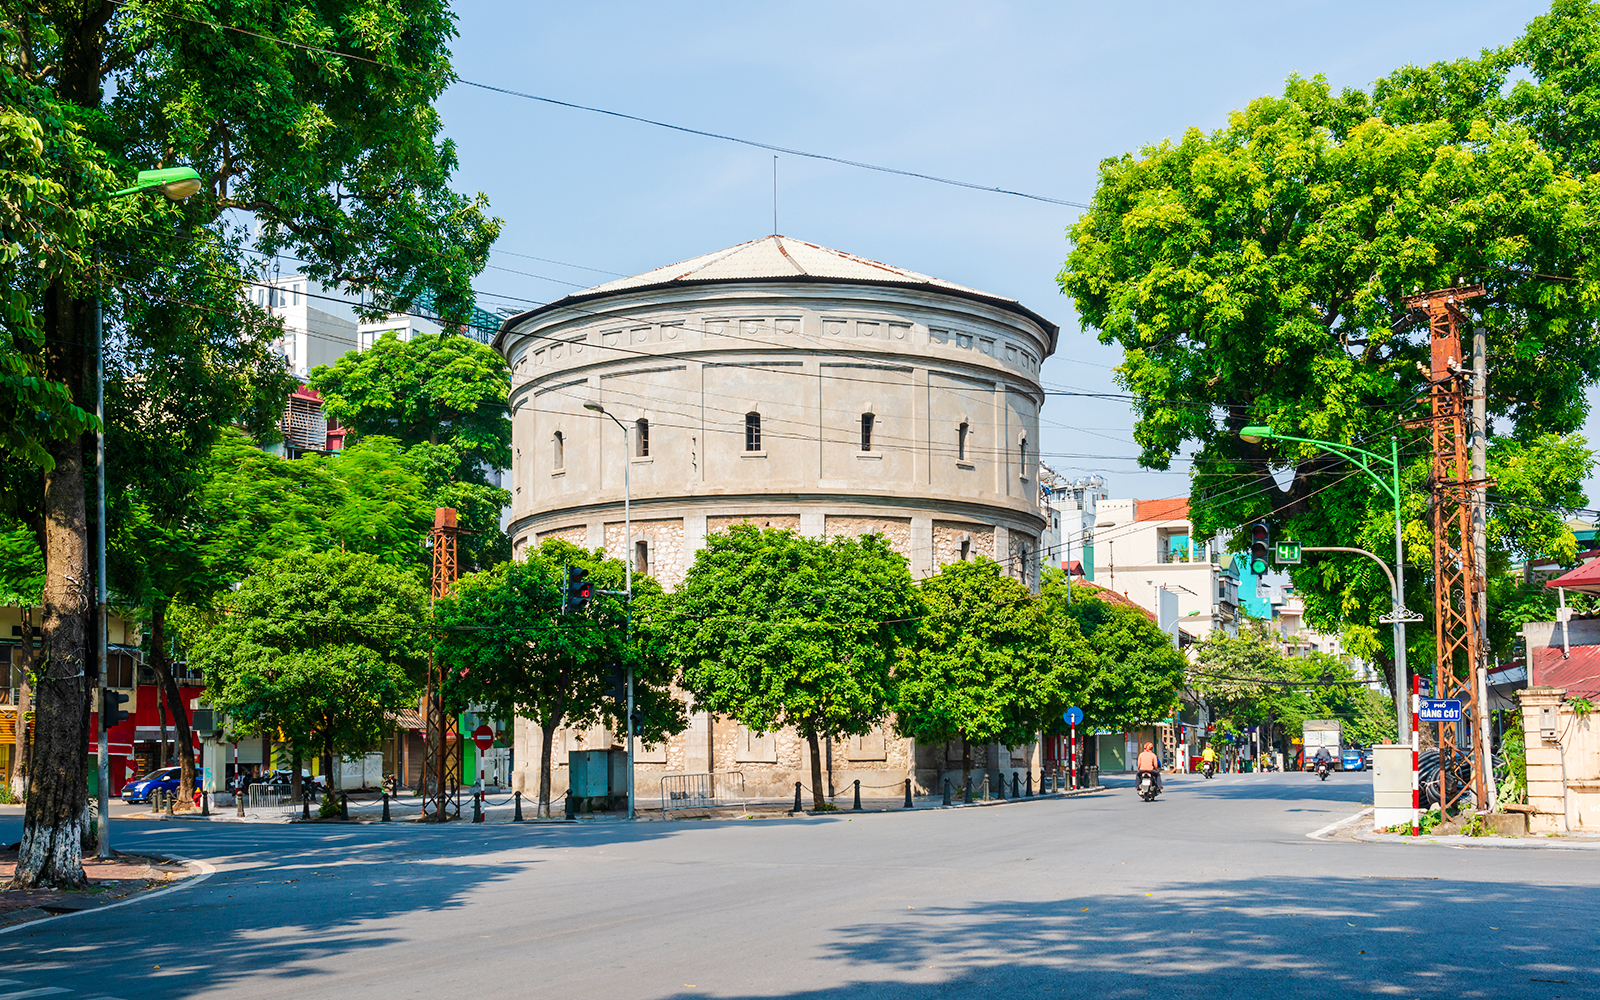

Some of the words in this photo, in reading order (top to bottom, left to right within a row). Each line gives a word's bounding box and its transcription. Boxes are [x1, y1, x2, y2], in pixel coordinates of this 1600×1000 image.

[1279, 546, 1298, 559] 41
[1421, 708, 1442, 718] HÀNG
[1444, 708, 1459, 718] CÓT
